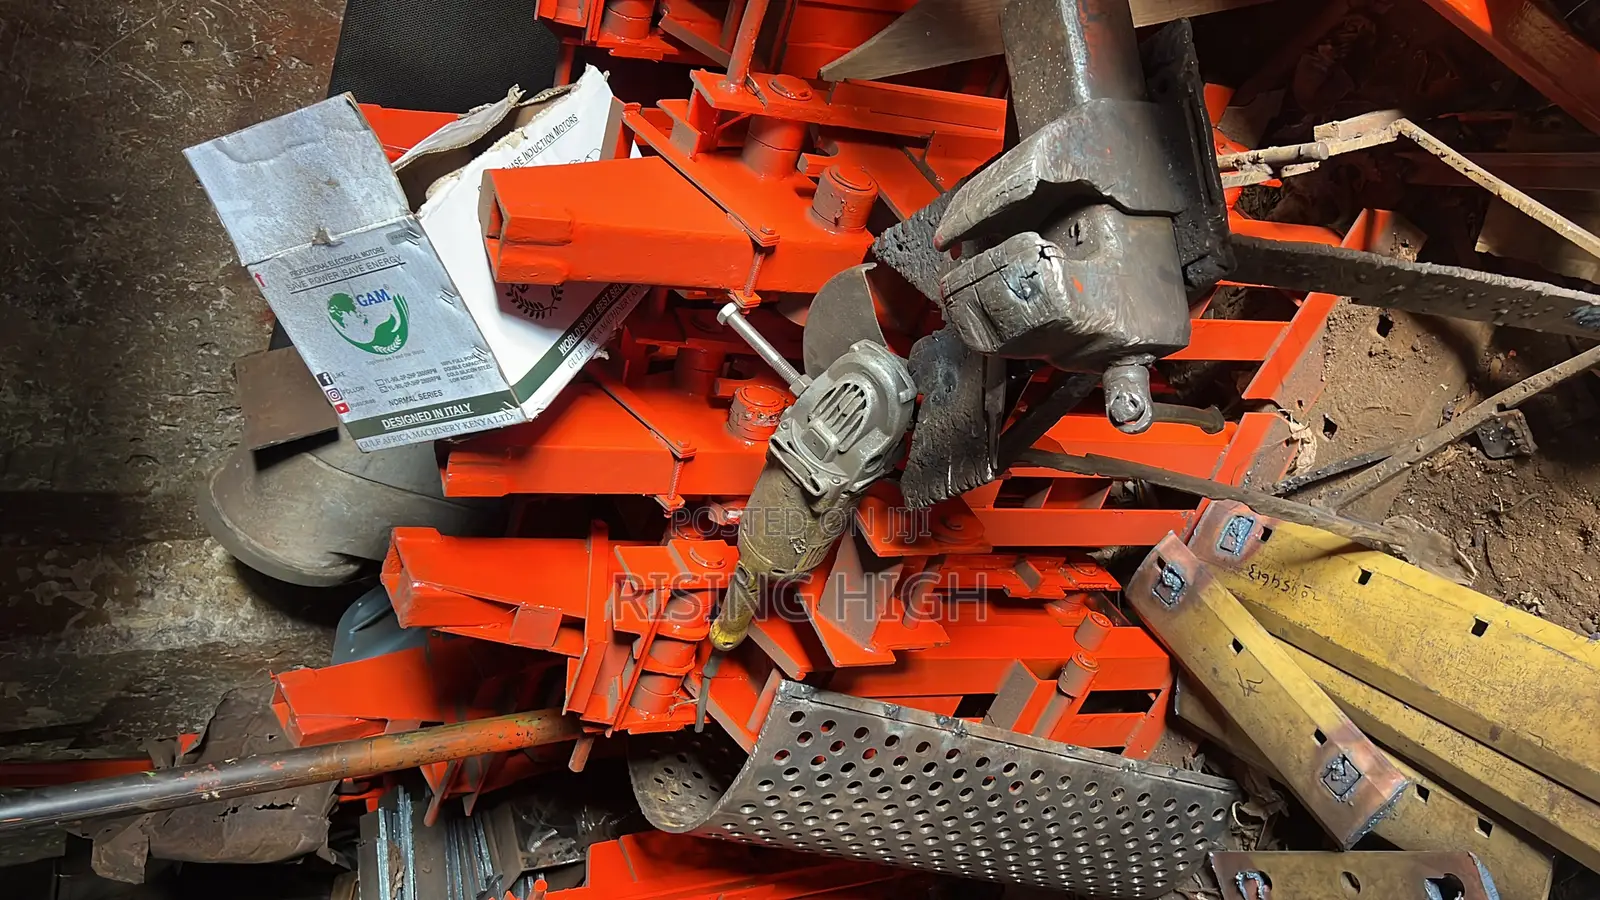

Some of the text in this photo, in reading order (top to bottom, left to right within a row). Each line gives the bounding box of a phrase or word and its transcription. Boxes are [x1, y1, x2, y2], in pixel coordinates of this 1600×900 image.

[521, 130, 555, 161] INDUCTION
[552, 113, 578, 136] MOTORS
[286, 280, 309, 292] SAVE
[342, 264, 366, 277] SAVE
[366, 254, 403, 270] ENERGY
[289, 246, 385, 278] PROFESSIONAL ELECTRICAL MOTORS
[355, 288, 391, 308] GAM
[558, 322, 587, 354] WORLD'S
[567, 348, 586, 369] GULF
[342, 386, 366, 395] FOLLOW
[387, 389, 444, 407] NORMAL SERIES
[381, 402, 474, 428] DESIGNED IN ITALY
[359, 438, 383, 449] GULF
[380, 433, 412, 445] AFRICA
[410, 422, 464, 439] MACHINERY
[462, 417, 494, 429] KENYA
